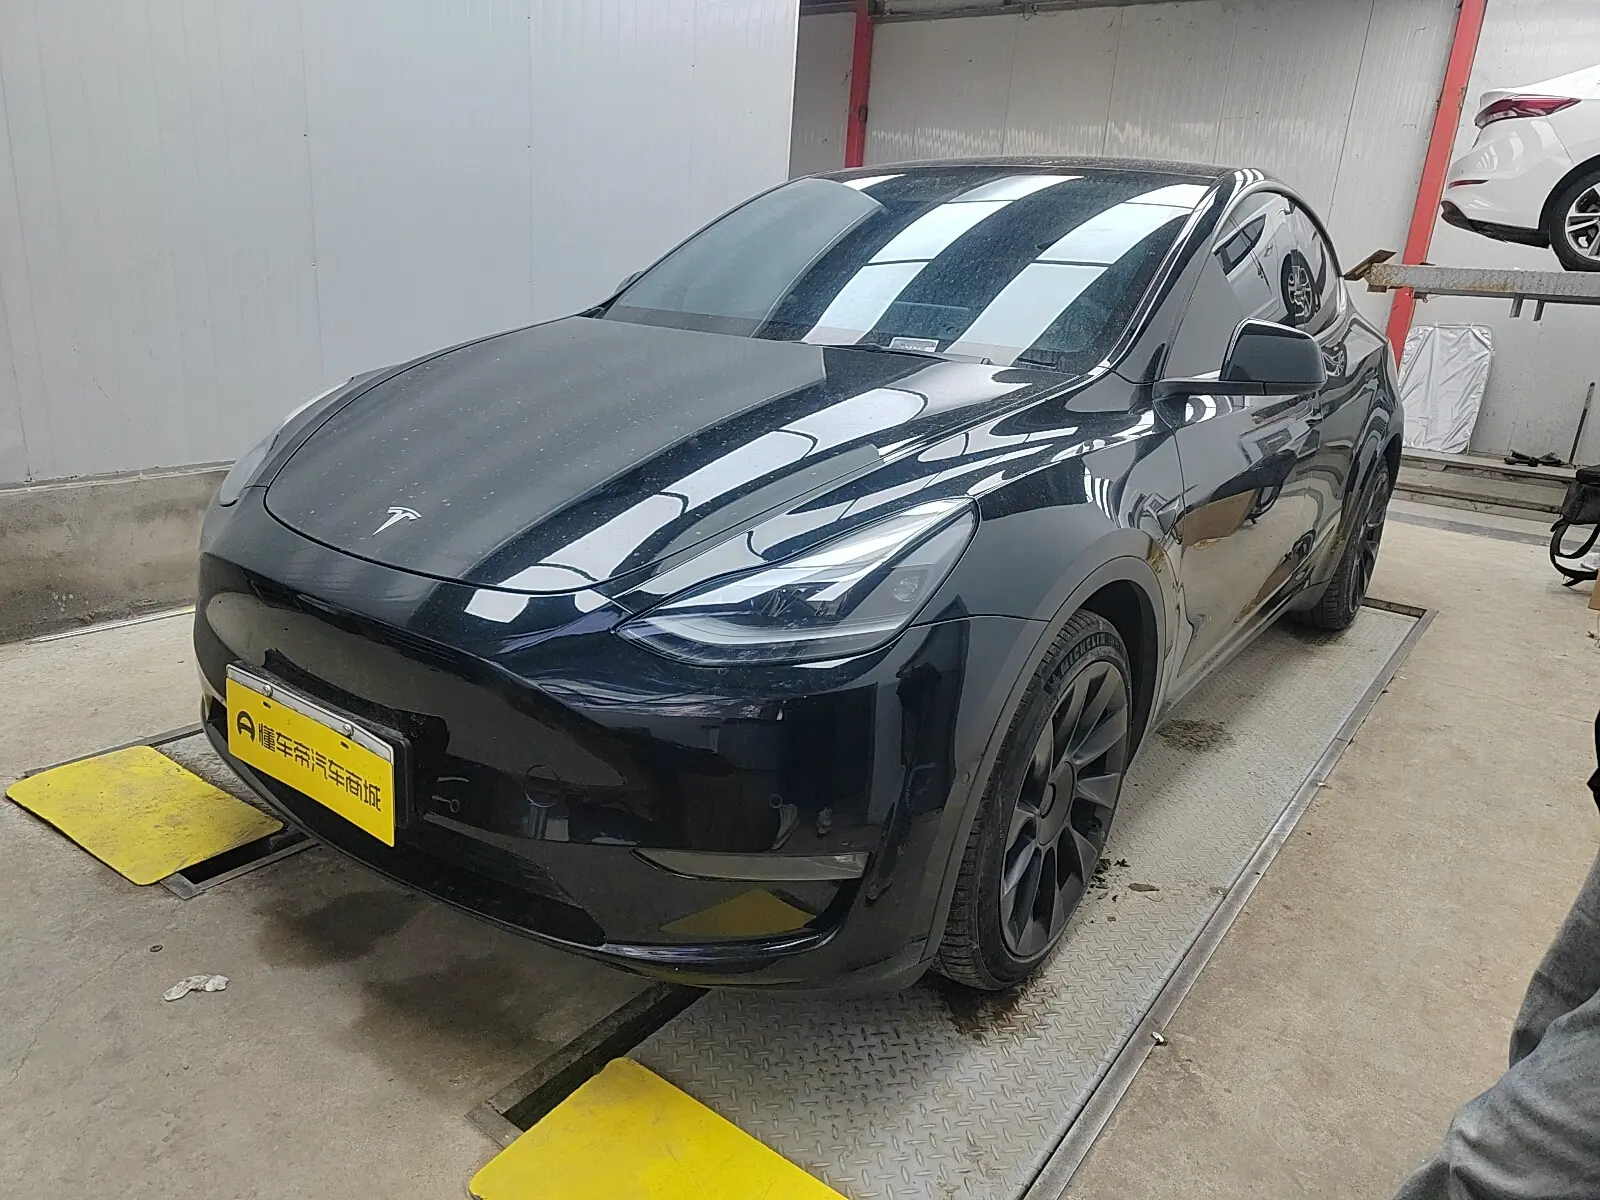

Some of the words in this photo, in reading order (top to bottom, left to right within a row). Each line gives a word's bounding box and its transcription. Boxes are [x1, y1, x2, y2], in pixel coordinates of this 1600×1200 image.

[1060, 633, 1106, 676] MICHELIN
[258, 722, 382, 812] 懂车帝汽车商城
